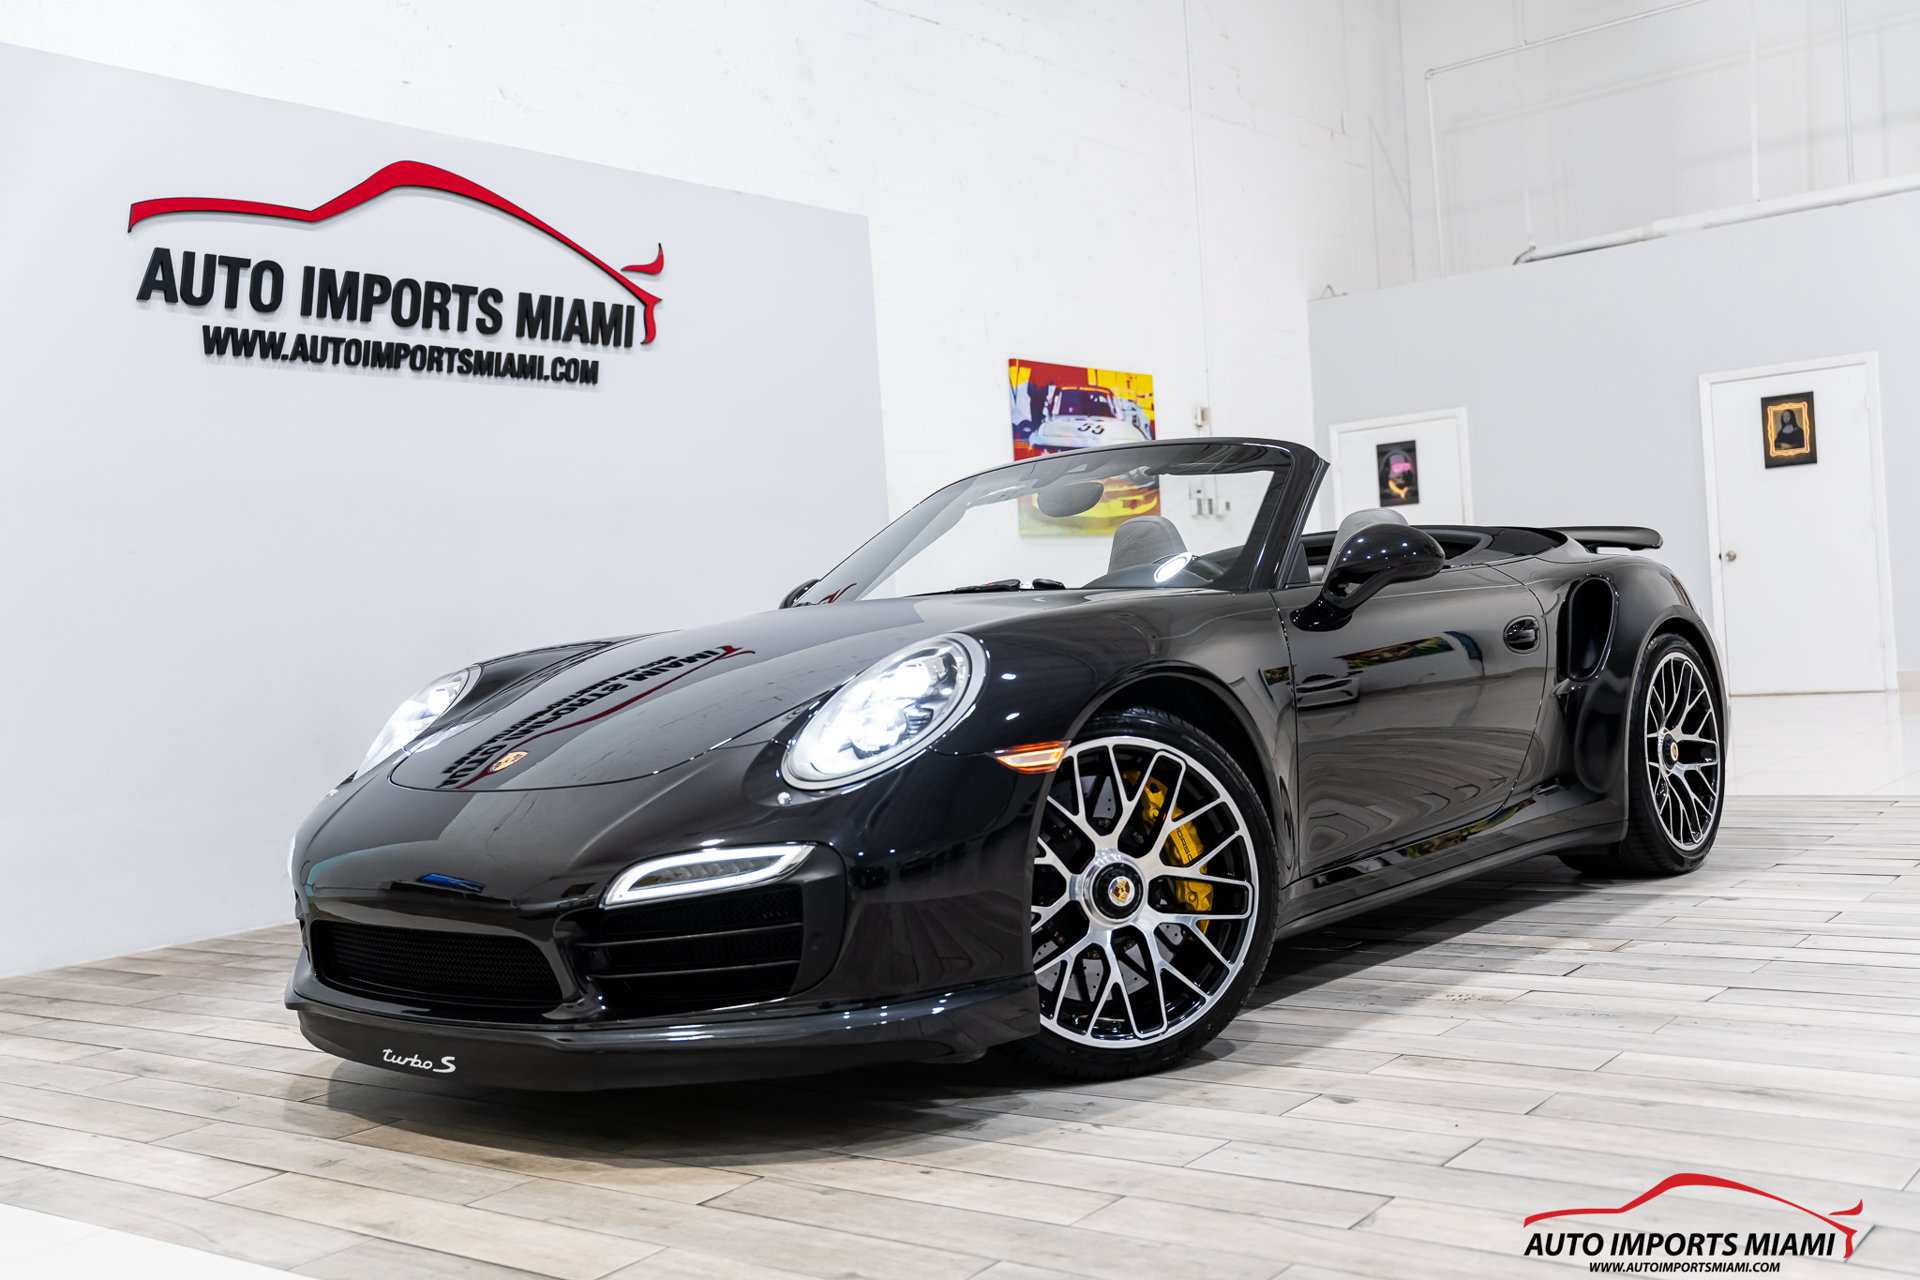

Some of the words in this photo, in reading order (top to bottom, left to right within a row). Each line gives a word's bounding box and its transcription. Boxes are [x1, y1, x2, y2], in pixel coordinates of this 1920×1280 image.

[137, 247, 285, 314] AUTO
[300, 265, 504, 336] IMPORTS
[515, 292, 636, 349] MIAMI
[202, 324, 599, 385] WWW.AUTOIMPORTSMIAMI.COM
[1077, 423, 1105, 435] 55
[382, 1048, 433, 1070] turbo
[432, 1056, 456, 1073] S
